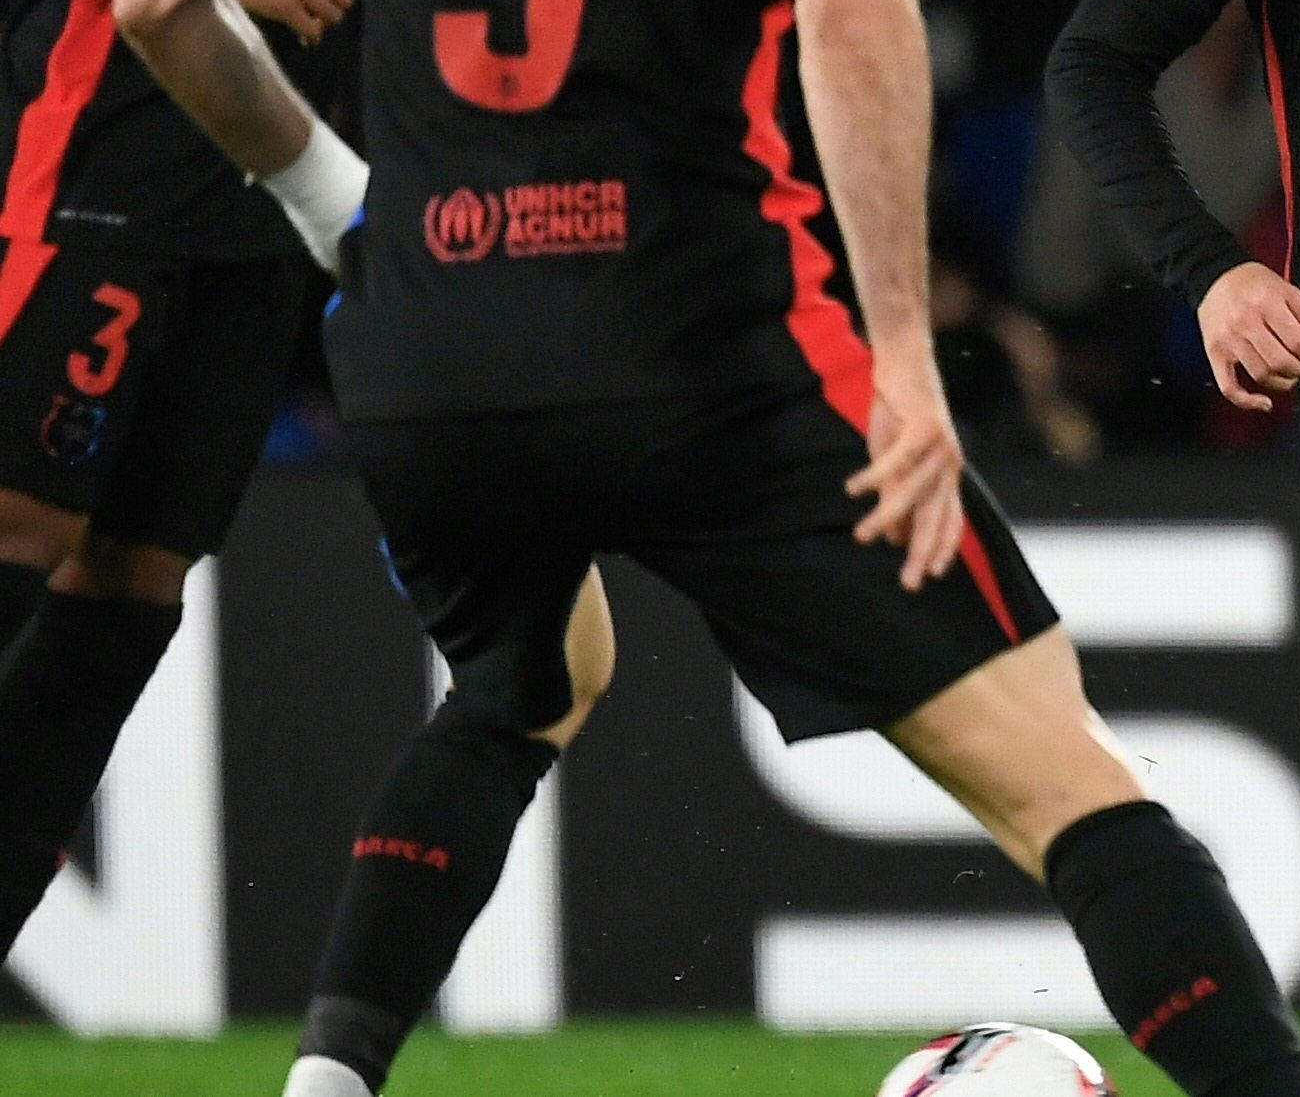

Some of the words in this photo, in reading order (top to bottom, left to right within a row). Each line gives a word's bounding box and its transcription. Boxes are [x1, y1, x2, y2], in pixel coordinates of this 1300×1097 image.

[503, 179, 627, 213] UNHCR
[504, 211, 627, 241] ACNUR
[67, 283, 142, 396] 3
